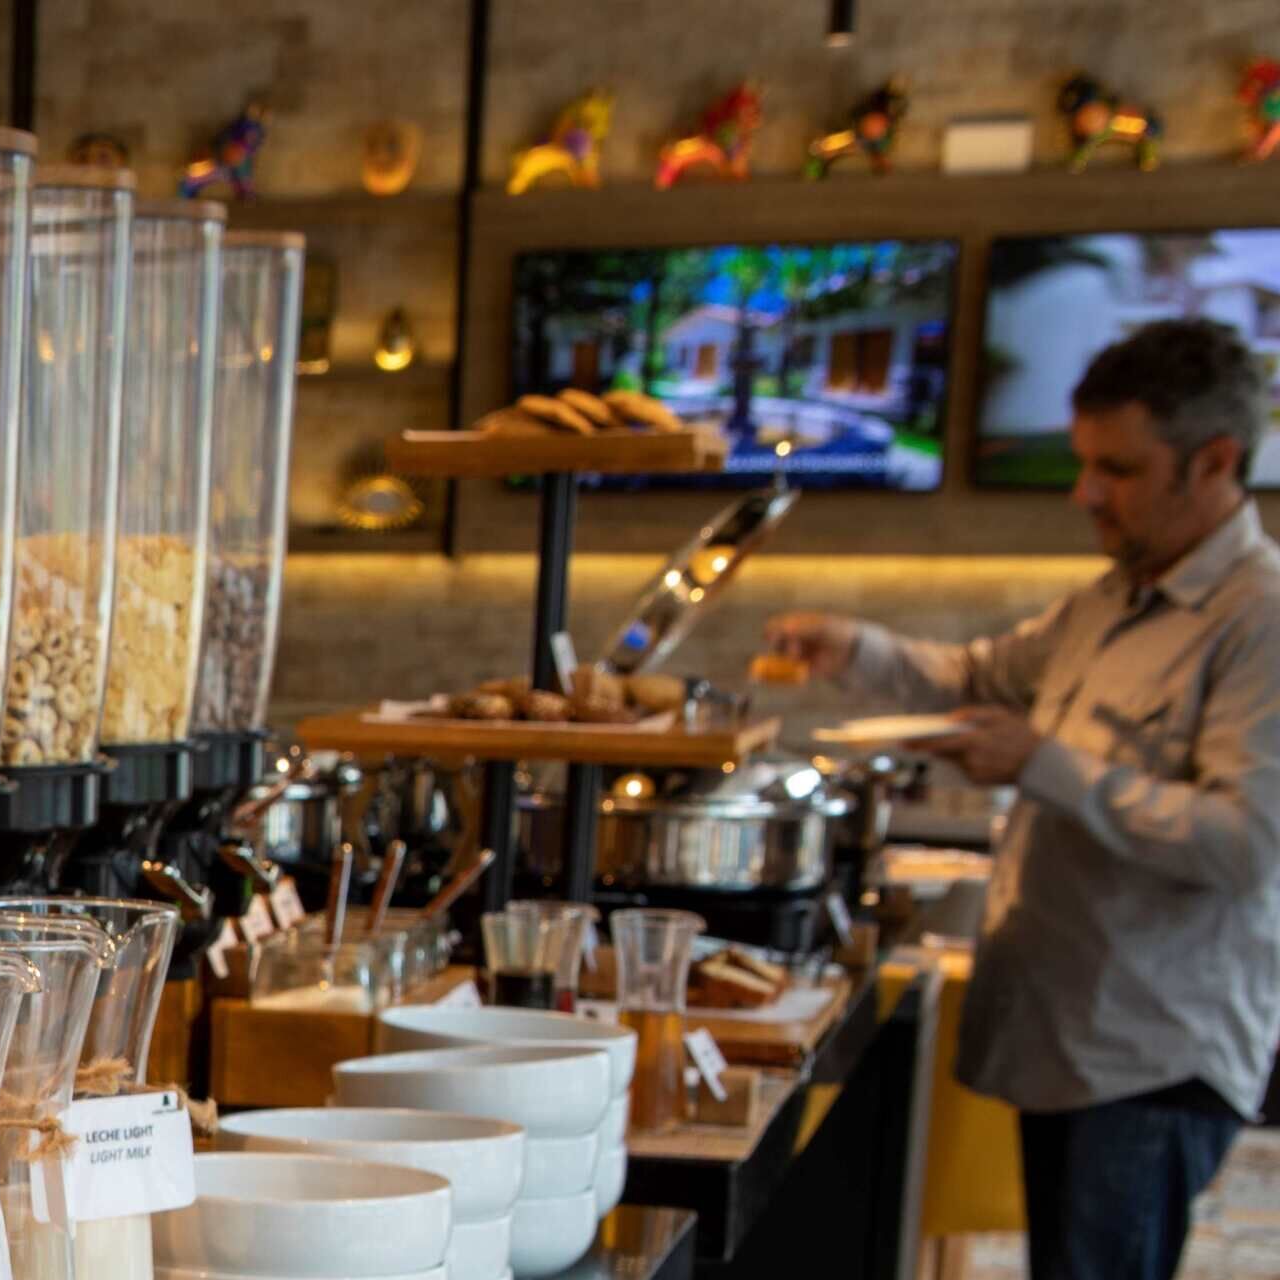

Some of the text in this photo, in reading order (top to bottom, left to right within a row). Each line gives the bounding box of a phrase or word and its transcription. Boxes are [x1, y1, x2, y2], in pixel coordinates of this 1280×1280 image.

[85, 1124, 154, 1144] LECHE LIGHT
[90, 1146, 152, 1165] LIGHT MILK
